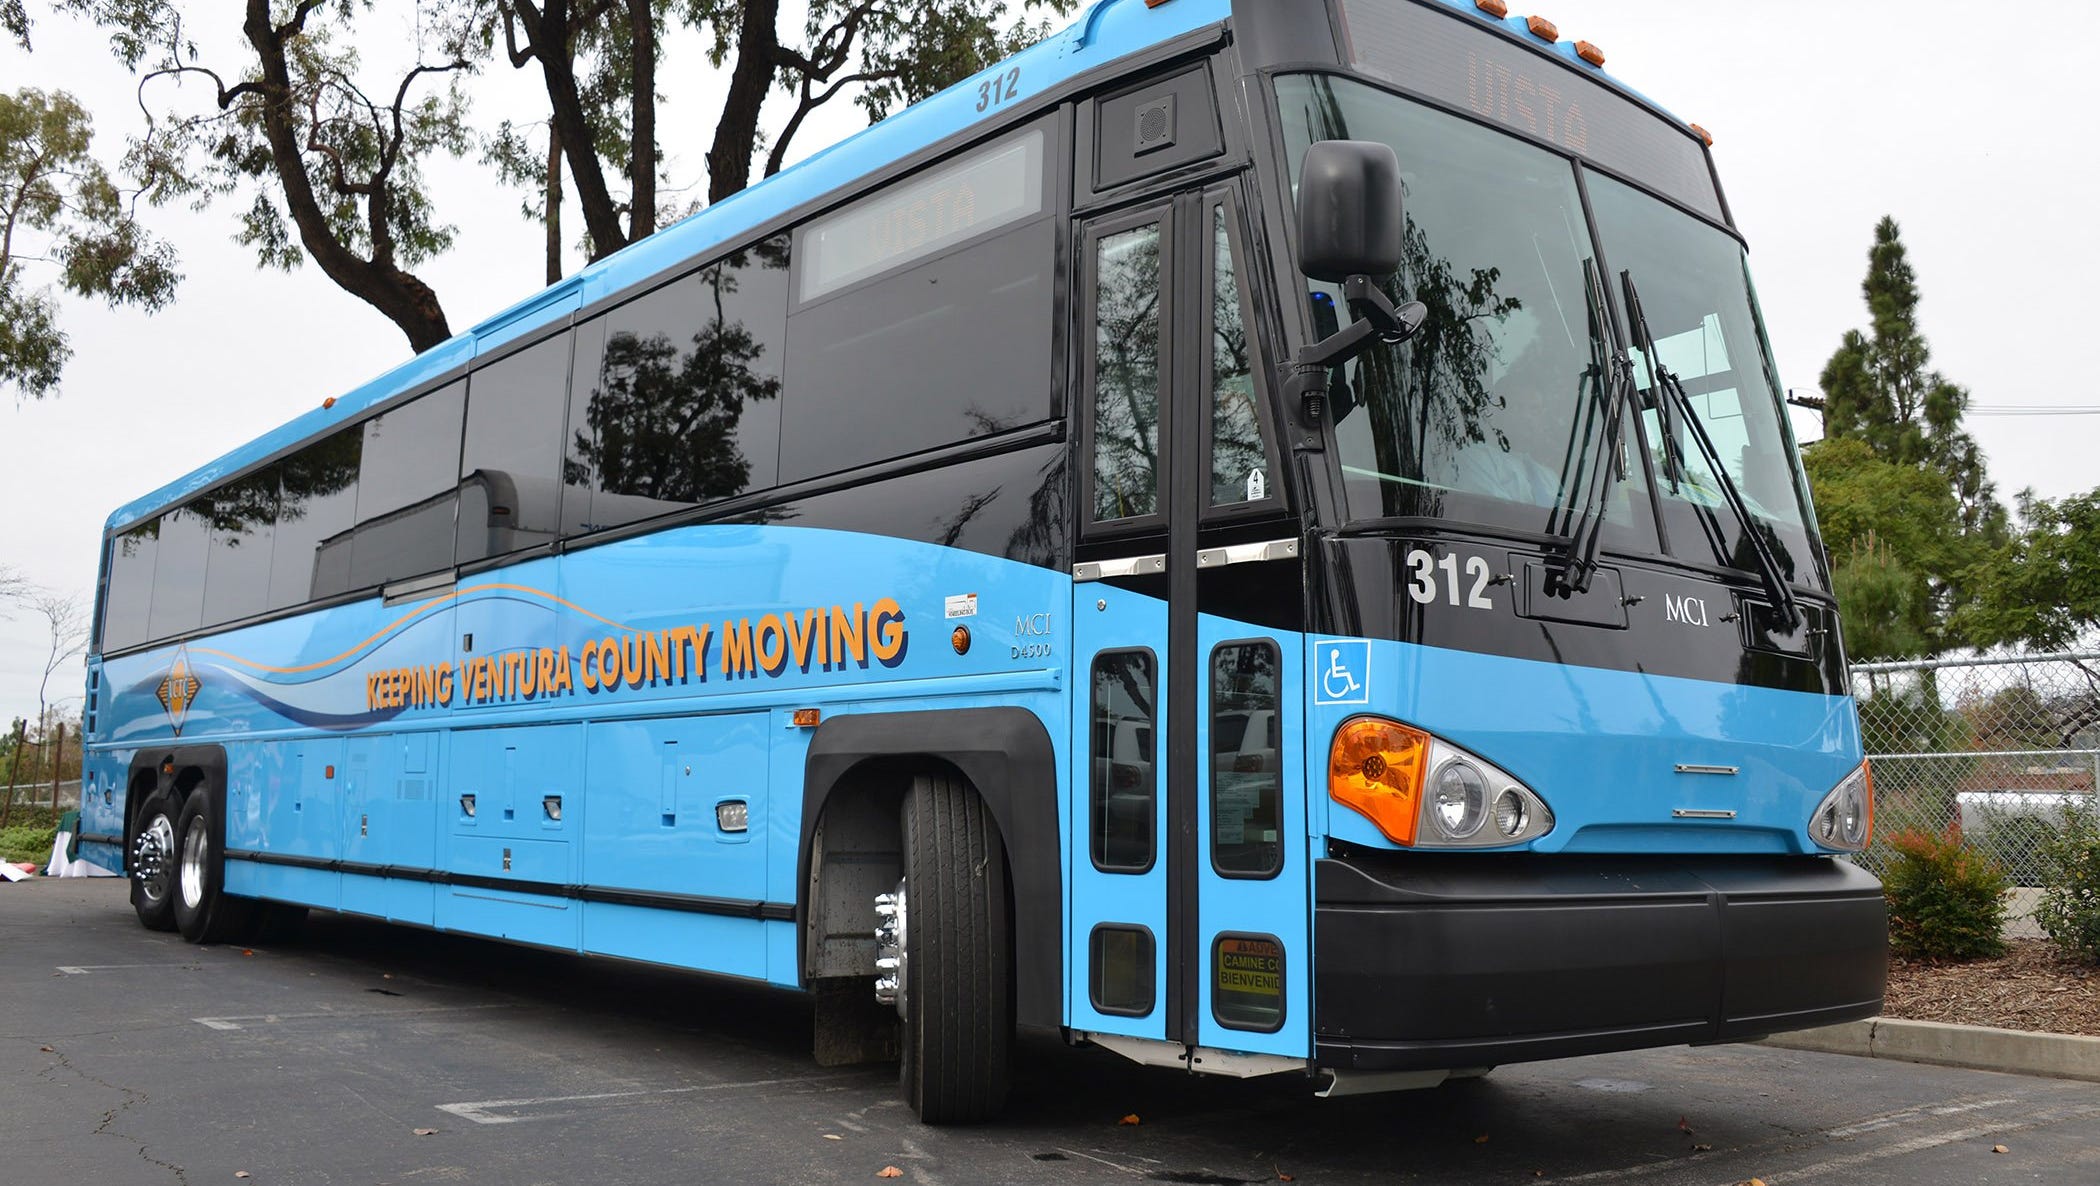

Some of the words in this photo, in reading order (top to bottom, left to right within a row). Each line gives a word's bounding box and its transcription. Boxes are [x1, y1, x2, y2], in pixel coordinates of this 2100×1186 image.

[976, 66, 1021, 113] 312
[1465, 50, 1587, 156] VISTA
[1406, 549, 1493, 610] 312
[1015, 613, 1052, 637] MCI
[1665, 593, 1709, 627] MCI
[367, 661, 454, 710] KEEPING
[459, 645, 574, 704] VENTURA
[580, 623, 713, 693] COUNTY
[721, 597, 908, 680] MOVING
[1011, 642, 1052, 659] D4500
[1224, 955, 1265, 969] CAMINE
